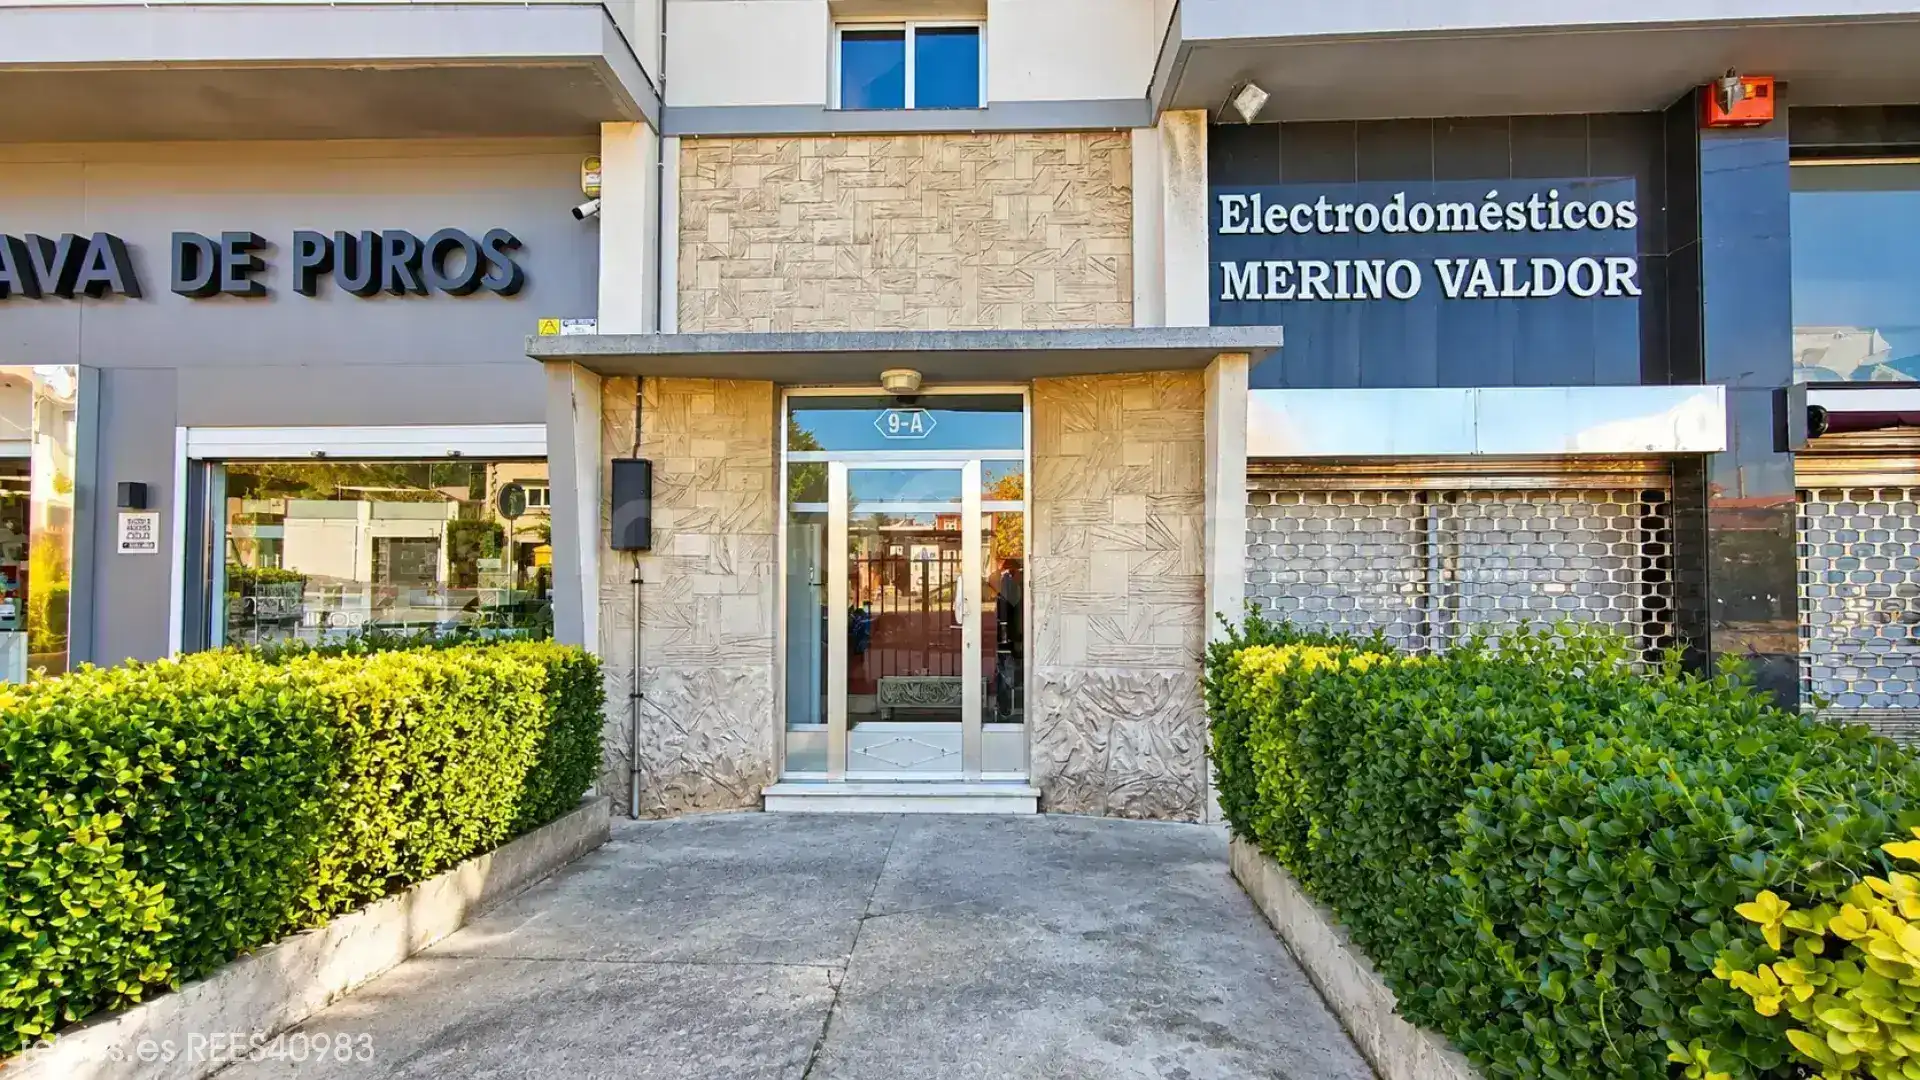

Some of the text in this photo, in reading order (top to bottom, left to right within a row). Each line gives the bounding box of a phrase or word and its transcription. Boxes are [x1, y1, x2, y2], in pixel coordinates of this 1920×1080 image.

[1218, 189, 1638, 235] Electrodomésticos
[171, 231, 266, 297] DE
[293, 228, 523, 297] PUROS
[1220, 256, 1642, 300] MERINO VALDOR
[888, 412, 923, 434] 9-A
